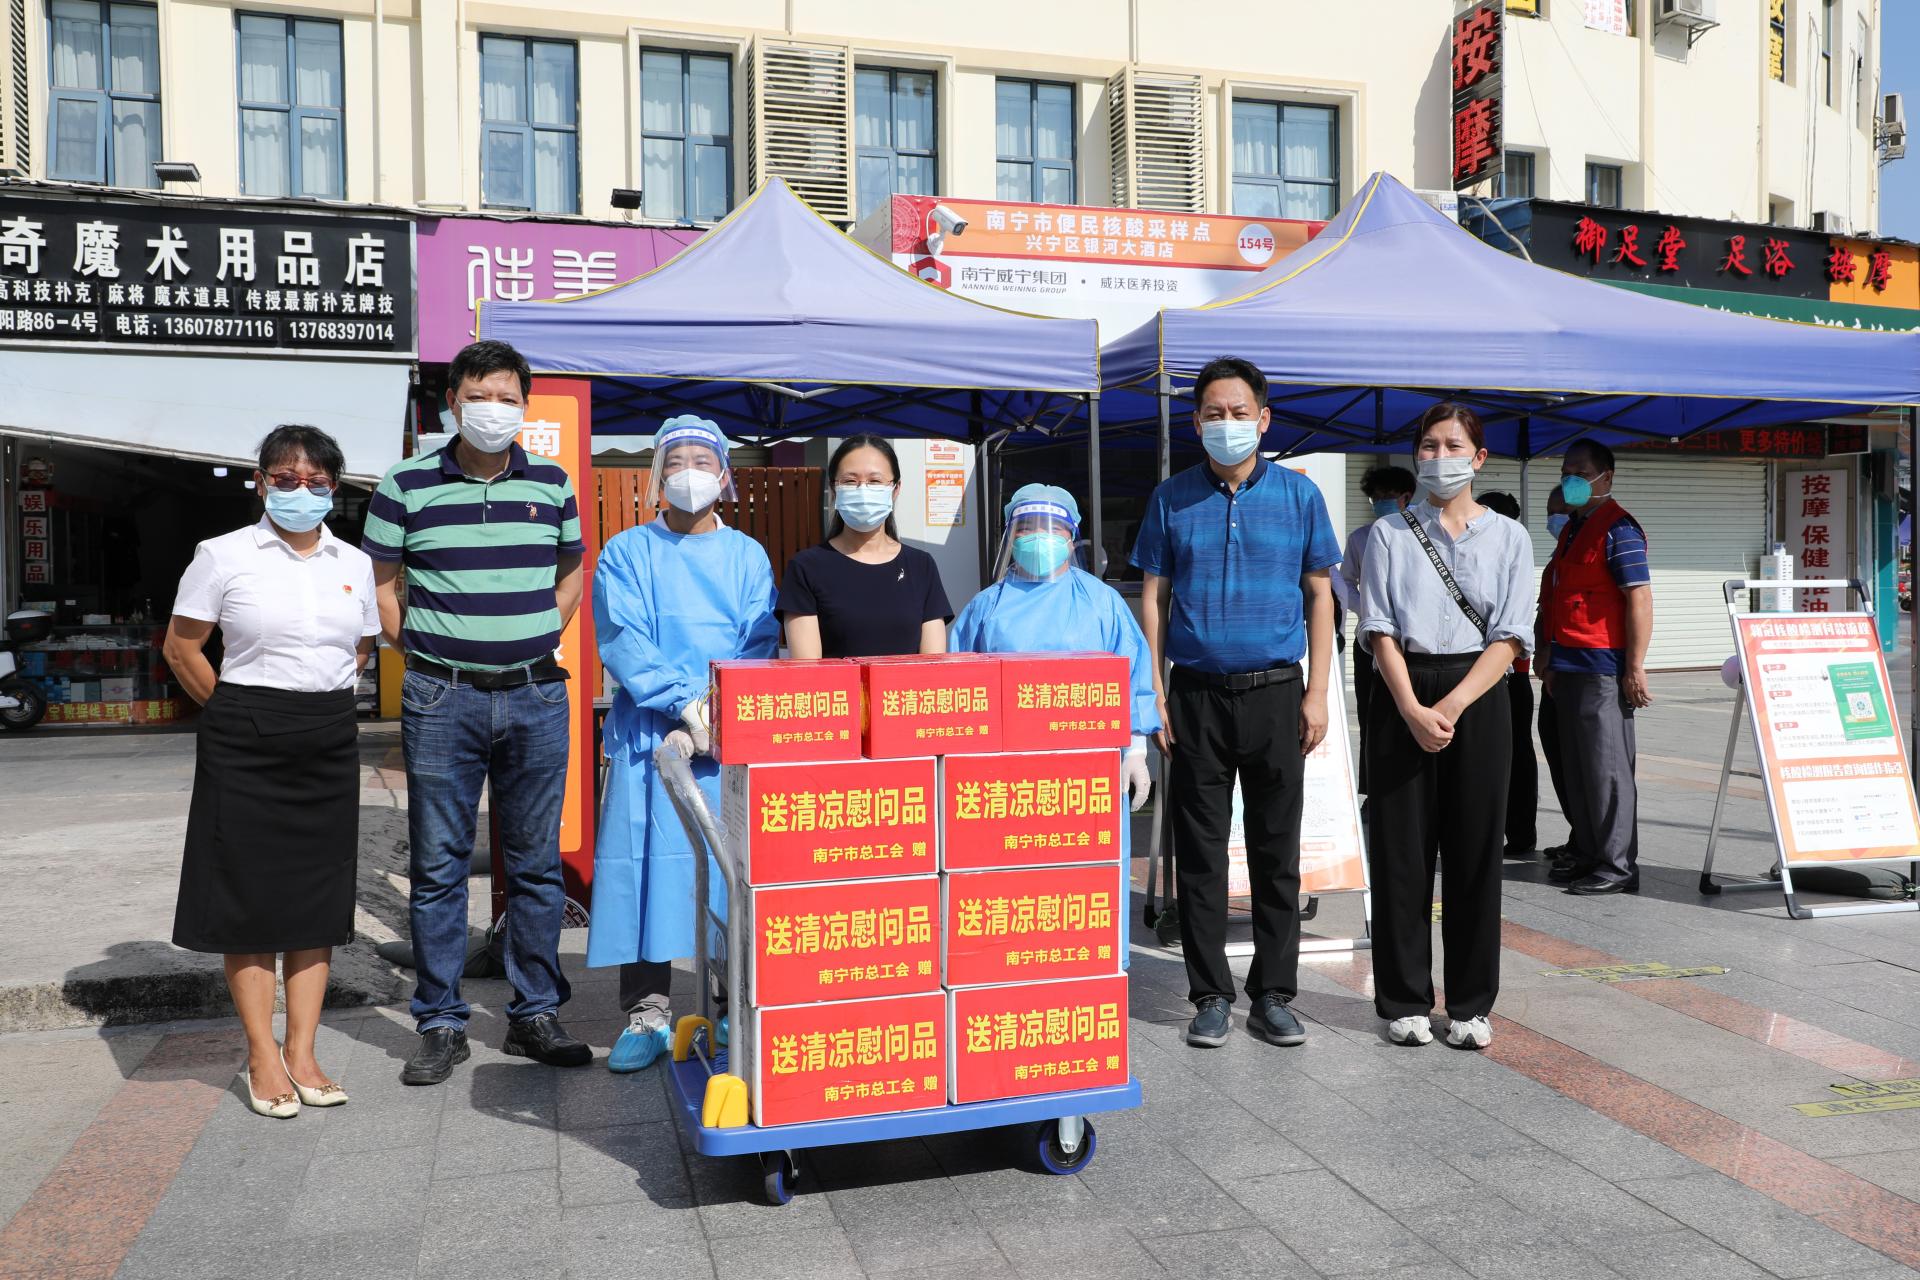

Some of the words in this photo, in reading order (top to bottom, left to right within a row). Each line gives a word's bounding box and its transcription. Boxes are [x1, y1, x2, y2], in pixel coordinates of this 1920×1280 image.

[1452, 5, 1498, 180] 按摩
[986, 209, 1211, 242] 南宁市便民核酸采样点
[0, 215, 385, 287] 奇魔术用品店
[1026, 234, 1175, 258] 兴宁区银河大酒店
[1239, 237, 1273, 251] 154号
[1575, 216, 1687, 272] 御足堂
[1723, 234, 1795, 276] 足浴
[1830, 246, 1892, 290] 按摩
[961, 266, 1067, 285] 南宁威宁集团
[1100, 277, 1179, 292] 威沃医养投资
[962, 282, 999, 292] NANNING
[1002, 285, 1037, 293] WEINING
[1040, 287, 1067, 295] GROUP
[108, 284, 145, 305] 麻将
[154, 285, 230, 308] 魔术道具
[246, 289, 394, 315] 传授最新扑克牌技
[289, 321, 394, 341] 13768397014
[23, 493, 46, 582] 娱乐用品
[1411, 521, 1428, 544] YOUNG
[1426, 546, 1448, 578] FOREVER
[1445, 575, 1463, 601] YOUNG
[736, 690, 849, 721] 送清凉慰问品
[882, 686, 989, 716] 送清凉慰问品
[1018, 682, 1121, 709] 送清凉慰问品
[772, 731, 834, 744] 南宁市总工会
[839, 730, 849, 740] 赠
[916, 726, 974, 738] 南宁市总工会
[980, 725, 989, 735] 赠
[1049, 720, 1106, 731] 南宁市总工会
[1111, 719, 1120, 730] 赠
[761, 786, 927, 833] 送清凉慰问品
[956, 777, 1112, 820] 送清凉慰问品
[813, 842, 904, 863] 南宁市总工会
[912, 841, 927, 857] 赠
[1004, 831, 1090, 850] 南宁市总工会
[1098, 830, 1111, 846] 赠
[957, 892, 1111, 937] 送清凉慰问品
[765, 905, 931, 956] 送清凉慰问品
[1006, 945, 1090, 966] 南宁市总工会
[1098, 945, 1111, 960] 赠
[818, 962, 909, 984] 南宁市总工会
[918, 960, 932, 975] 赠
[966, 1003, 1120, 1054] 送清凉慰问品
[771, 1021, 938, 1075] 送清凉慰问品
[1014, 1058, 1099, 1080] 南宁市总工会
[1106, 1055, 1120, 1070] 赠
[824, 1078, 916, 1102] 南宁市总工会
[923, 1075, 938, 1091] 赠
